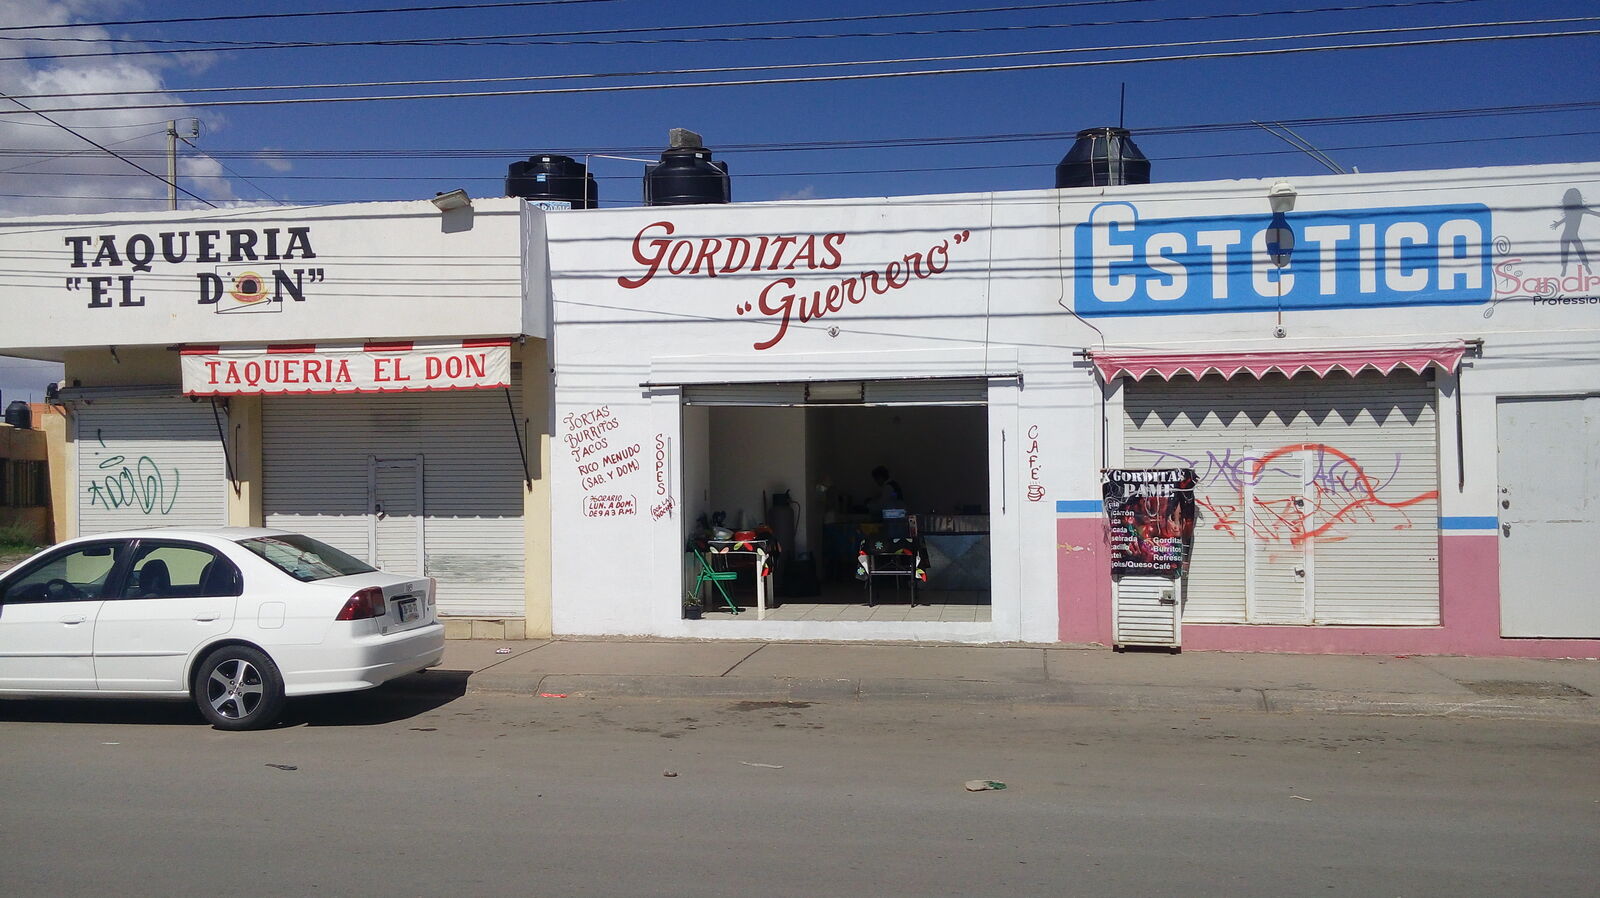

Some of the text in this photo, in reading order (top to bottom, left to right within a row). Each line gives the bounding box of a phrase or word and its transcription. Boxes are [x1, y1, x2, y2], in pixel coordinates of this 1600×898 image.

[65, 227, 316, 272] TAQUERIA
[617, 221, 846, 289] GORDITAS
[1533, 294, 1600, 305] Professio
[205, 353, 486, 387] TAQUERIA EL DON
[563, 405, 610, 431] TORTAS
[564, 418, 619, 448] BURRITOS
[571, 438, 608, 462] TACOS
[578, 443, 640, 476] RICO MENUDO
[607, 471, 613, 480] Y
[655, 434, 665, 495] SOPES
[1113, 470, 1185, 482] GORDITAS
[1123, 483, 1175, 497] PAME
